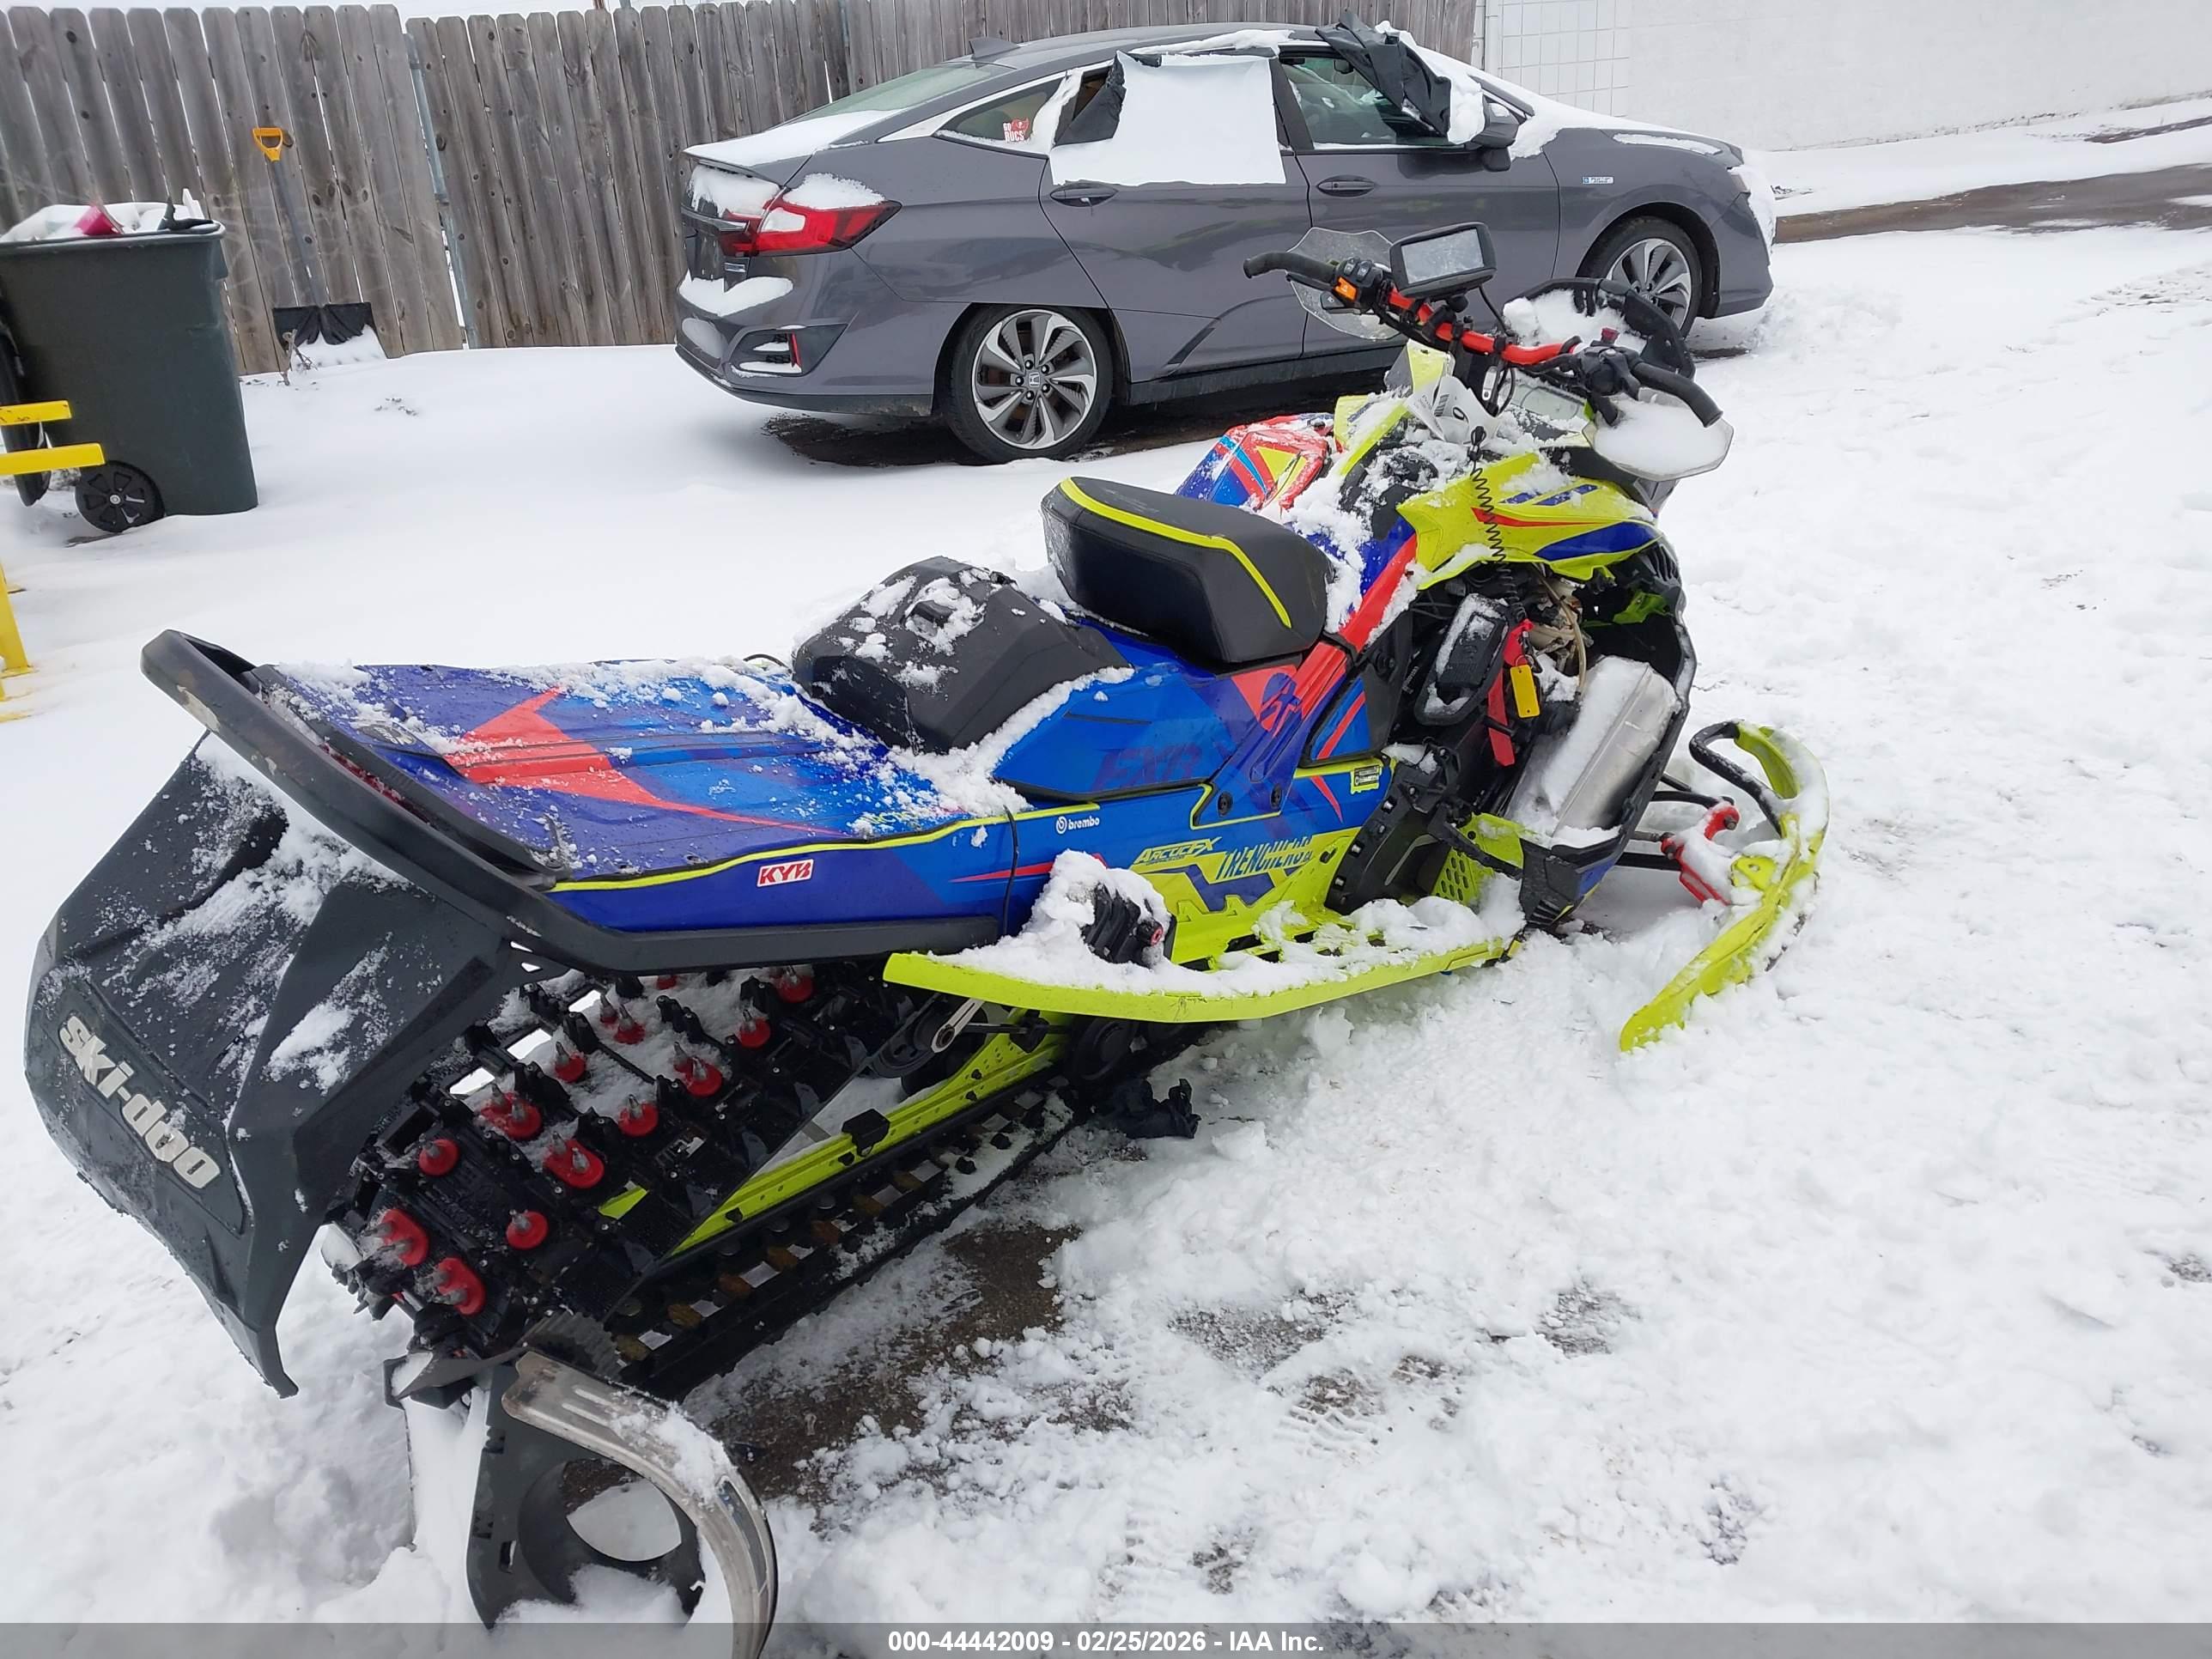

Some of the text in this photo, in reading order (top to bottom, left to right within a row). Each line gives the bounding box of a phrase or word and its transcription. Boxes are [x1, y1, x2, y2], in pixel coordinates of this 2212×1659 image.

[1005, 130, 1025, 143] BUCS
[1067, 815, 1100, 830] brembo
[759, 860, 812, 884] KYB
